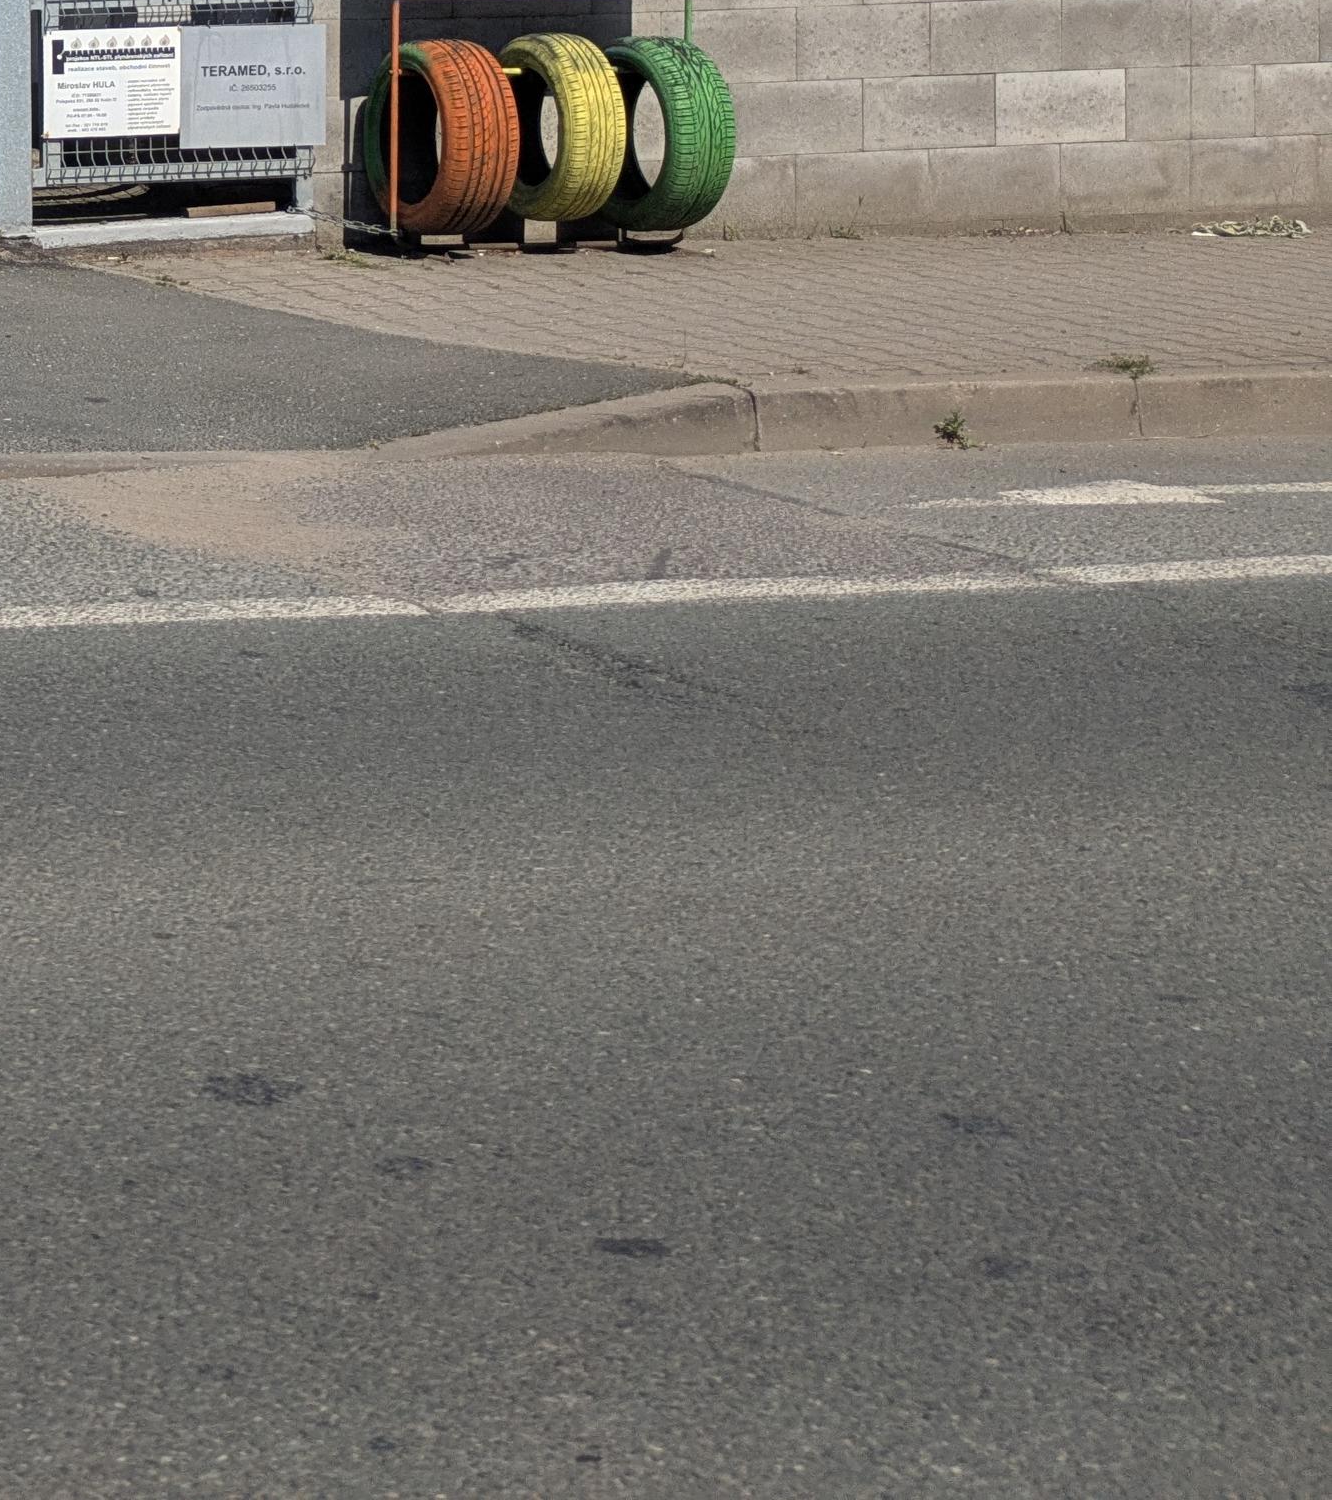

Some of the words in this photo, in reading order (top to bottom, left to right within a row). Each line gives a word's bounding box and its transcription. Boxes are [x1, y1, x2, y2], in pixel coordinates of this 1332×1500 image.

[201, 64, 271, 77] TERAMED,
[274, 65, 306, 76] s.r.o.
[57, 82, 91, 90] Miroslav
[92, 81, 115, 89] HULA
